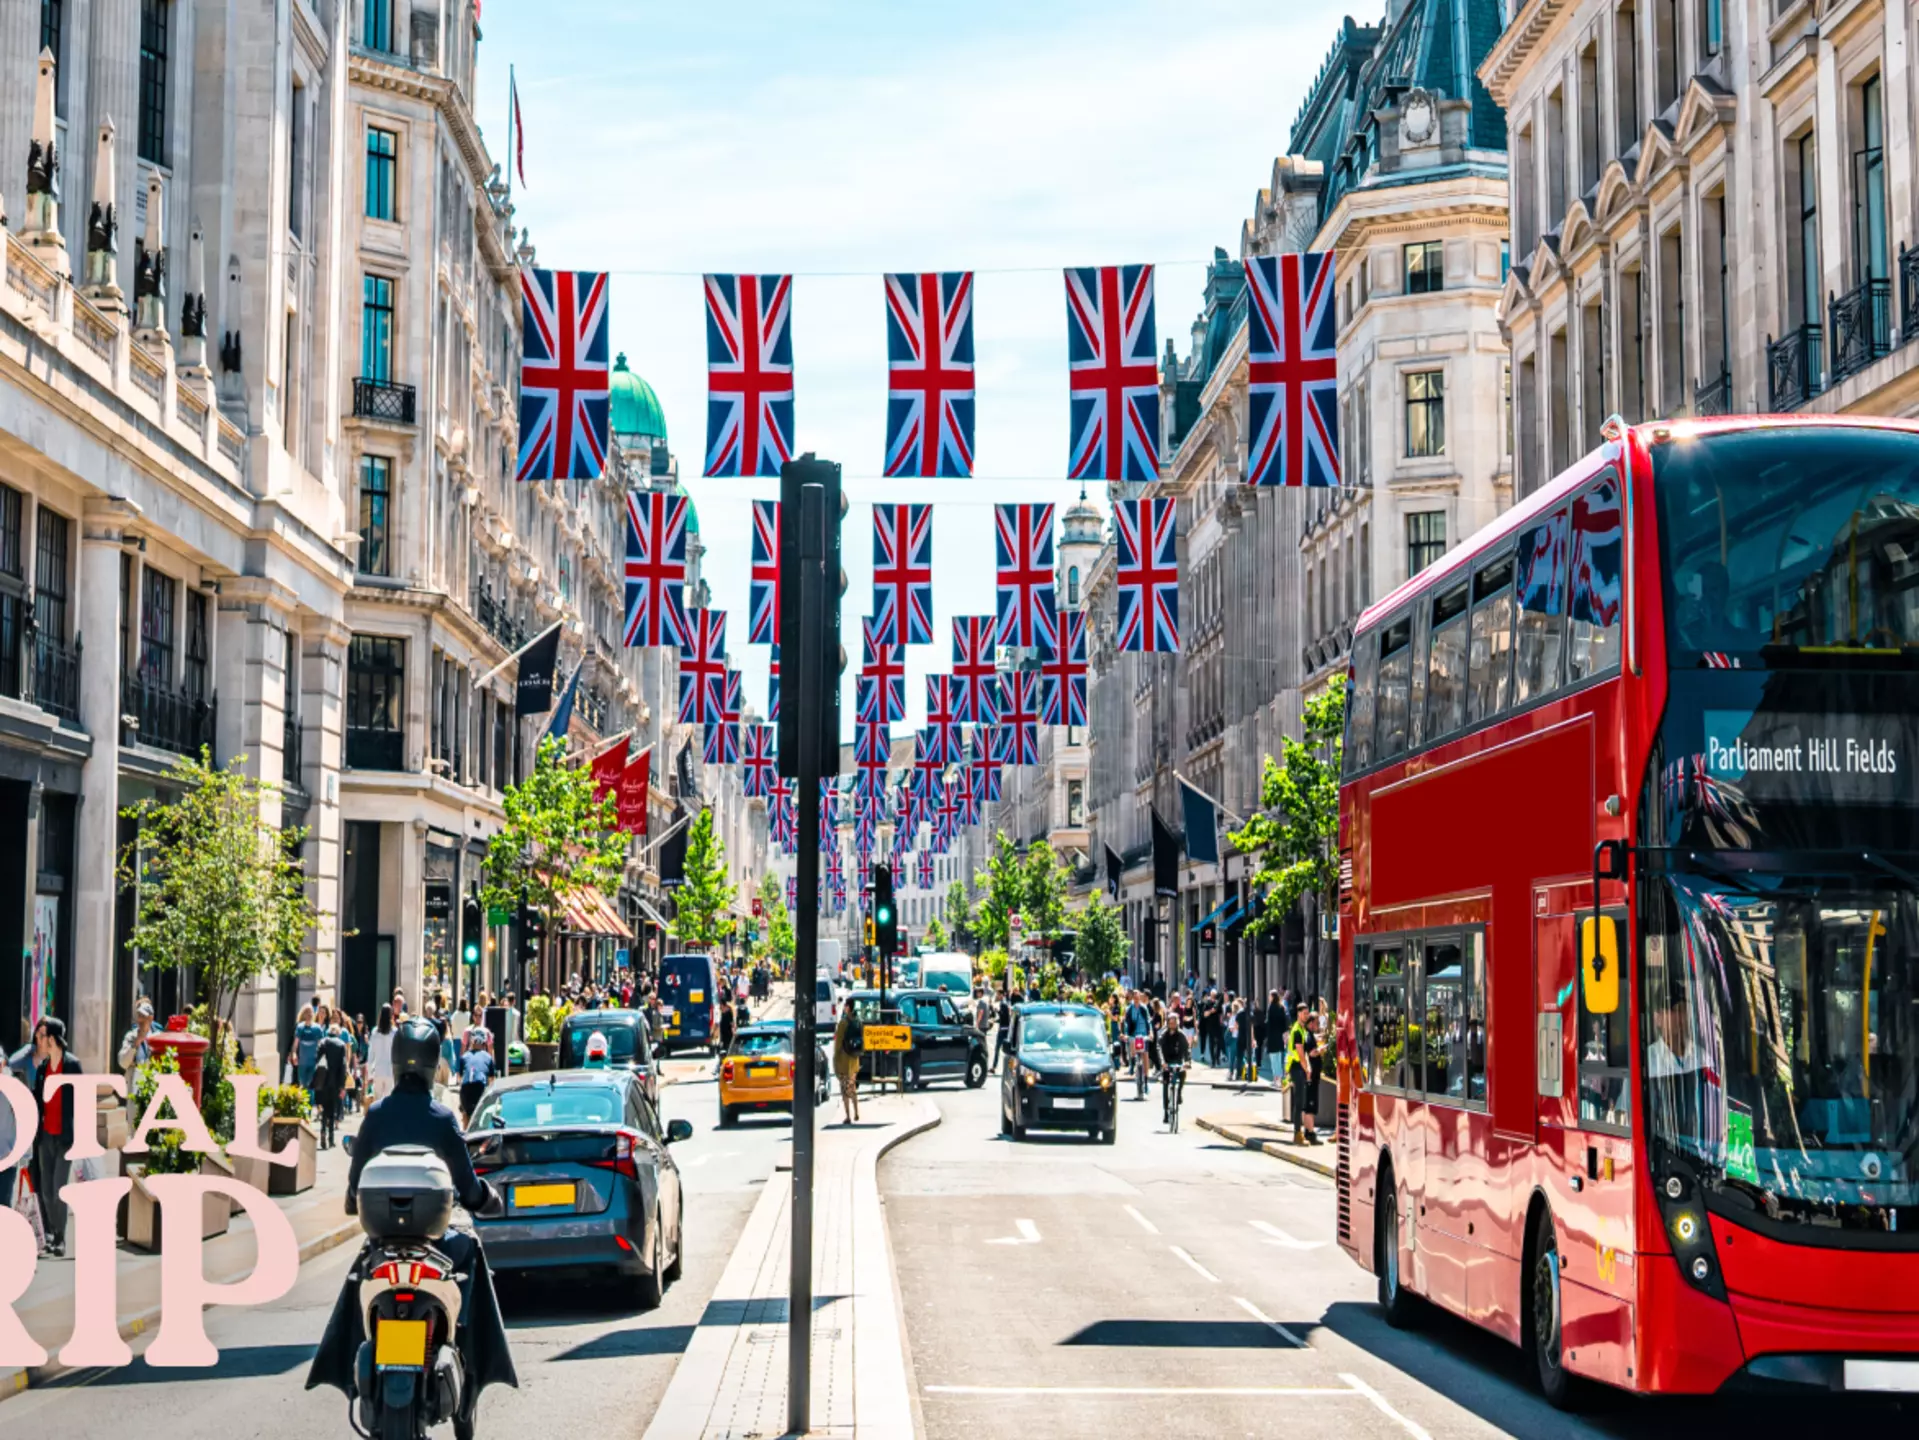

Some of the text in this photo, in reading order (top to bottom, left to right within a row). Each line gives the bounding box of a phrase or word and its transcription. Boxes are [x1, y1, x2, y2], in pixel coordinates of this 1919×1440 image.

[1709, 736, 1897, 773] Parliament Hill Fields
